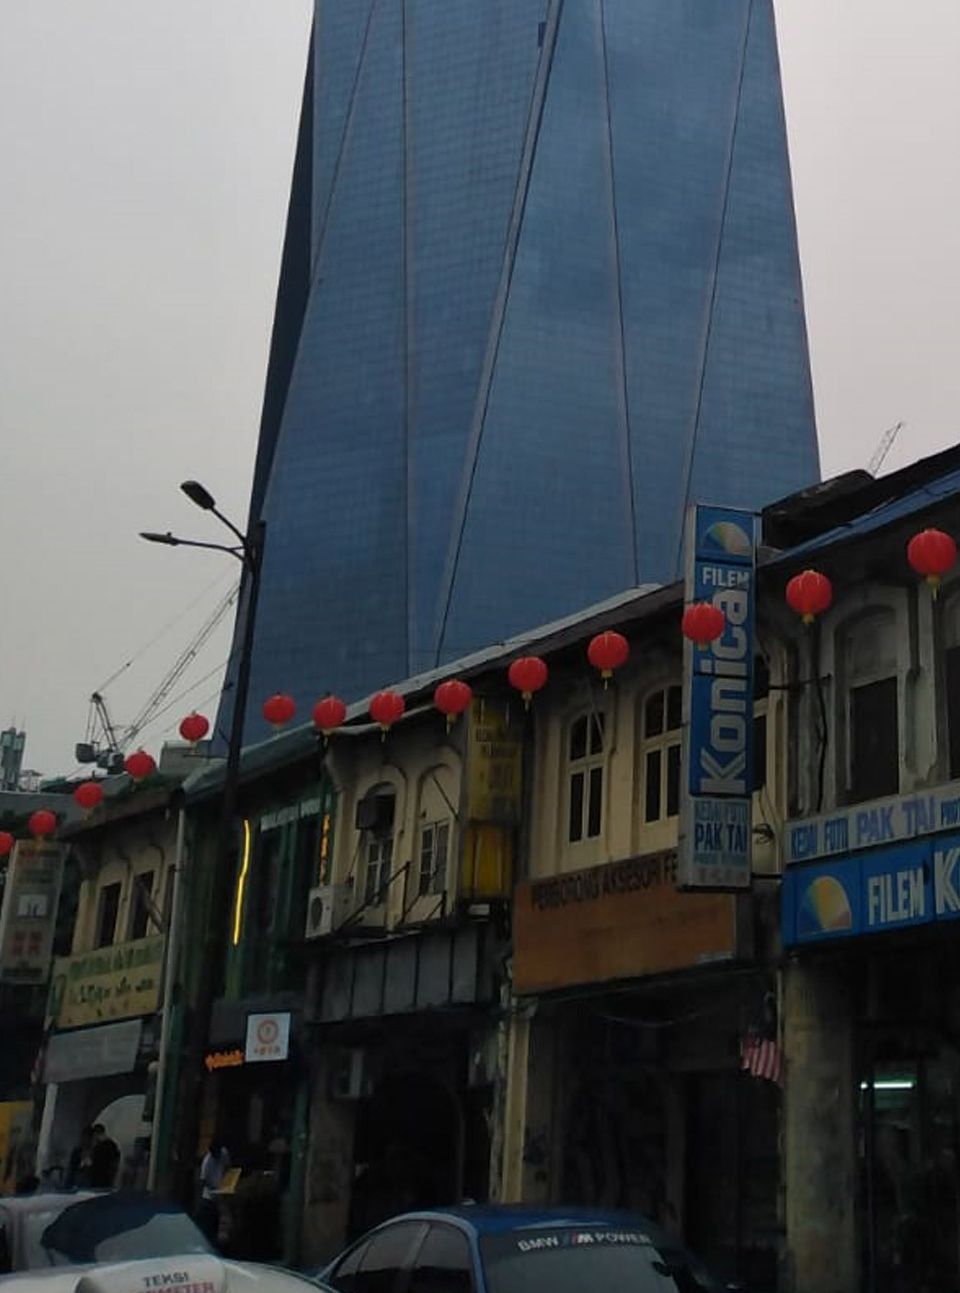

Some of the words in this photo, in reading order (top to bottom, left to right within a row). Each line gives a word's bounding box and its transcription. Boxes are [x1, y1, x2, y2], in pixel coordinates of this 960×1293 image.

[702, 565, 749, 588] FILEM
[699, 588, 749, 794] Konica
[856, 805, 893, 844] PAK
[903, 793, 936, 833] TAI
[694, 823, 722, 851] PAK
[726, 824, 747, 852] TAI
[868, 866, 925, 926] FILEM
[517, 1235, 559, 1252] BMW
[143, 1271, 189, 1288] TEKSI
